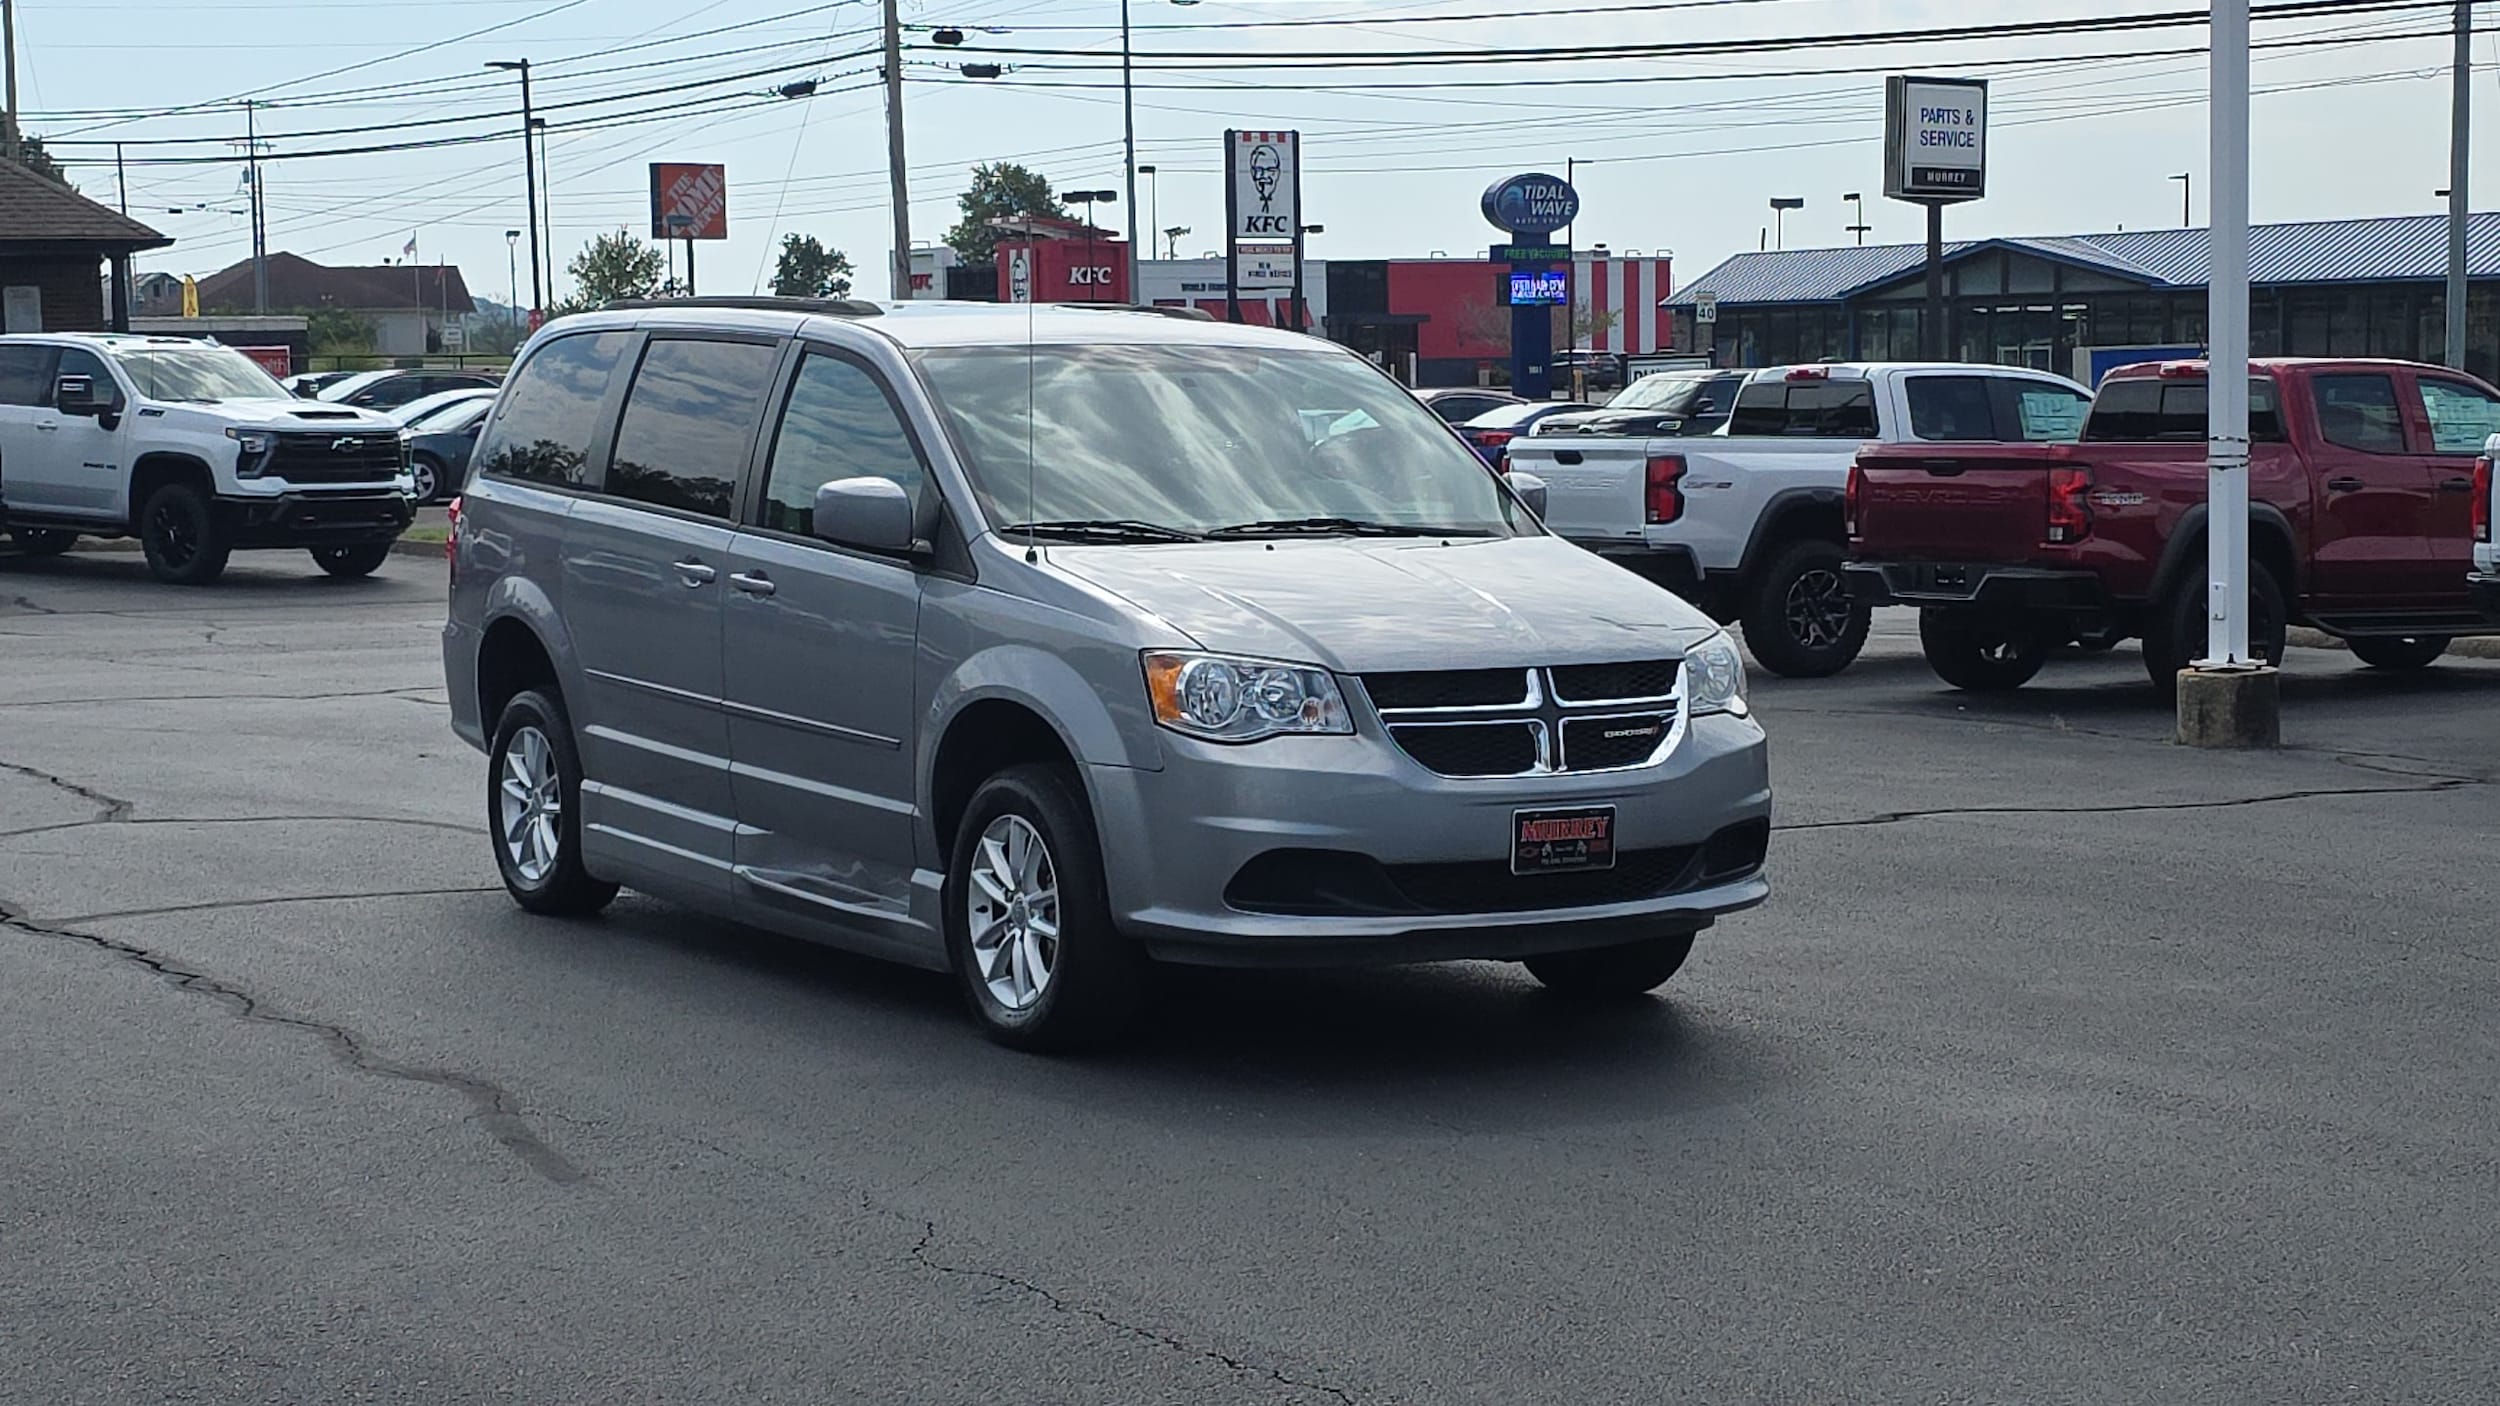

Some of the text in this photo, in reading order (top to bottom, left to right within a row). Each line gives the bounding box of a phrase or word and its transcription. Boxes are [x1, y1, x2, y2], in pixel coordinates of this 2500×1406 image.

[1920, 107, 1974, 125] PARTS &
[1920, 130, 1975, 147] SERVICE
[667, 172, 694, 200] THE
[1524, 184, 1565, 200] TIDAL
[1530, 200, 1573, 216] WAVE
[1245, 215, 1288, 233] KFC
[1069, 266, 1112, 284] KFC
[1698, 308, 1714, 320] 40
[1521, 816, 1610, 842] MURREY
